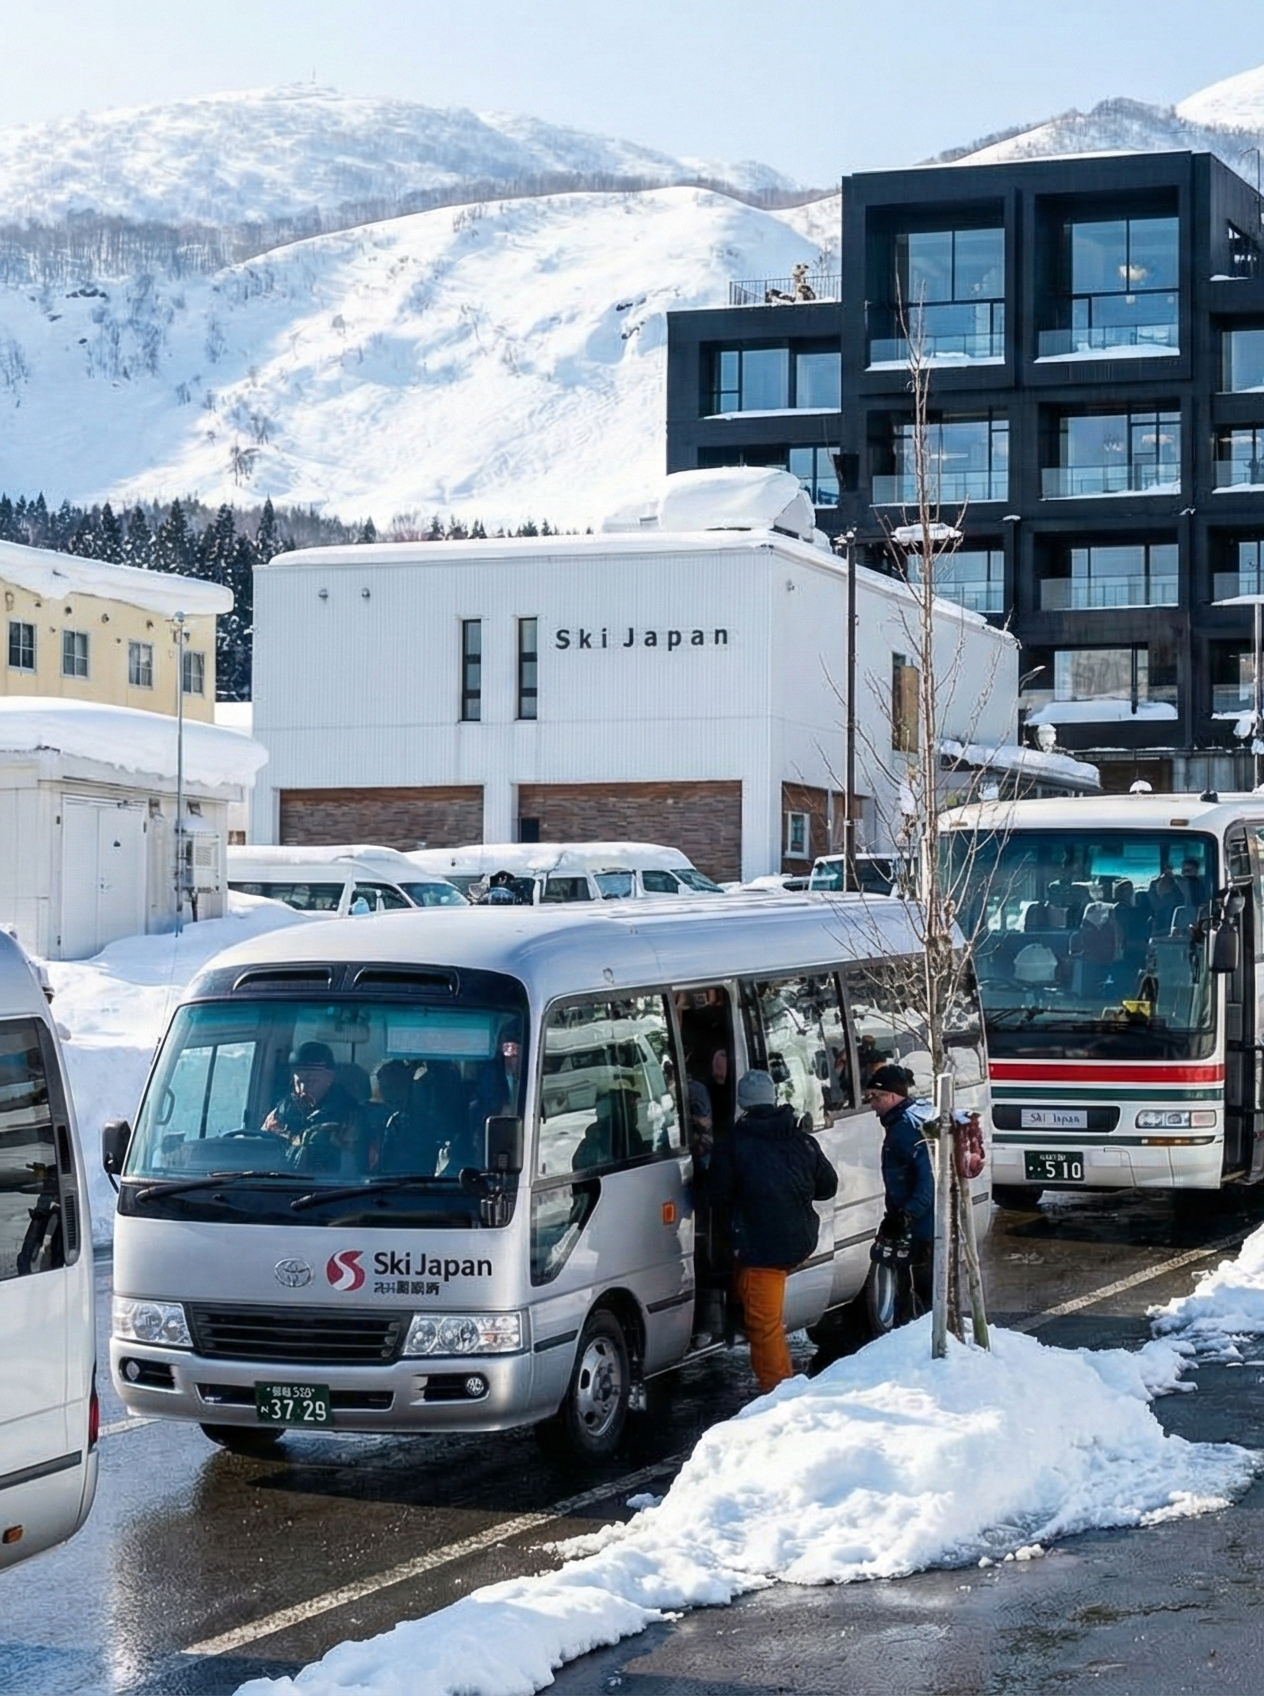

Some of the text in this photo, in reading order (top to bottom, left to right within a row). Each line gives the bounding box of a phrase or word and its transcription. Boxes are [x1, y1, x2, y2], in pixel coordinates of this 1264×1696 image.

[555, 628, 728, 651] Ski Japan
[374, 1251, 492, 1282] Ski Japan
